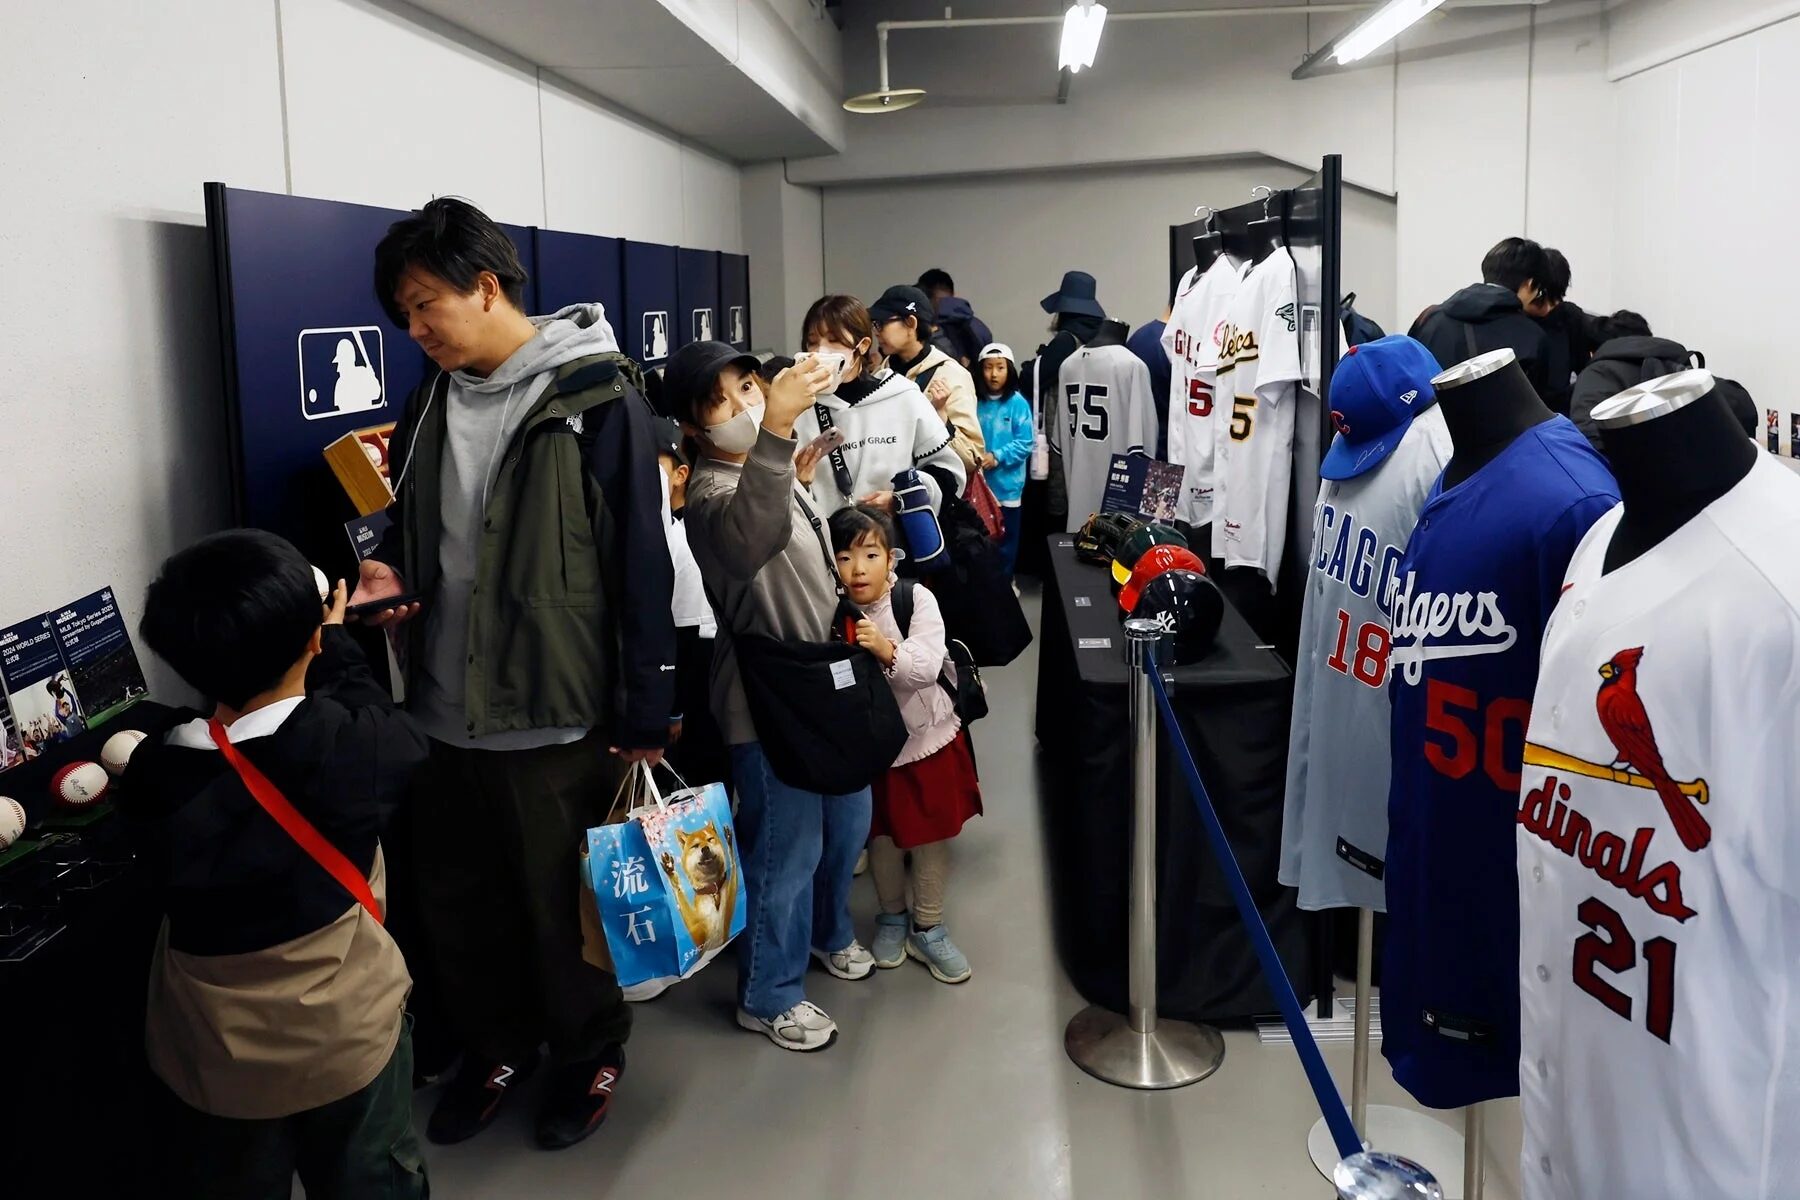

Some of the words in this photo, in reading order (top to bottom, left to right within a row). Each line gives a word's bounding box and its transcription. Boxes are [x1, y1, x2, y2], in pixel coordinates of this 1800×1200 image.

[1065, 383, 1109, 442] 55
[1330, 410, 1350, 434] C
[867, 436, 897, 445] GRACE
[1314, 502, 1405, 620] CAGO
[56, 612, 77, 625] MUSEUM
[59, 624, 72, 634] MLB
[72, 618, 87, 630] Tokyo
[86, 608, 101, 621] Series
[101, 604, 114, 614] 2025
[62, 627, 84, 641] presented
[83, 624, 91, 632] by
[90, 611, 116, 627] Guggenheim
[1389, 570, 1517, 687] dgers
[2, 646, 16, 656] 2024
[16, 638, 34, 651] WORLD
[34, 631, 51, 643] SERIES
[1327, 608, 1391, 689] 18
[1424, 677, 1533, 793] 50
[611, 856, 656, 946] 流石
[1572, 896, 1677, 1046] 21
[493, 1065, 515, 1088] N
[596, 1071, 615, 1093] N
